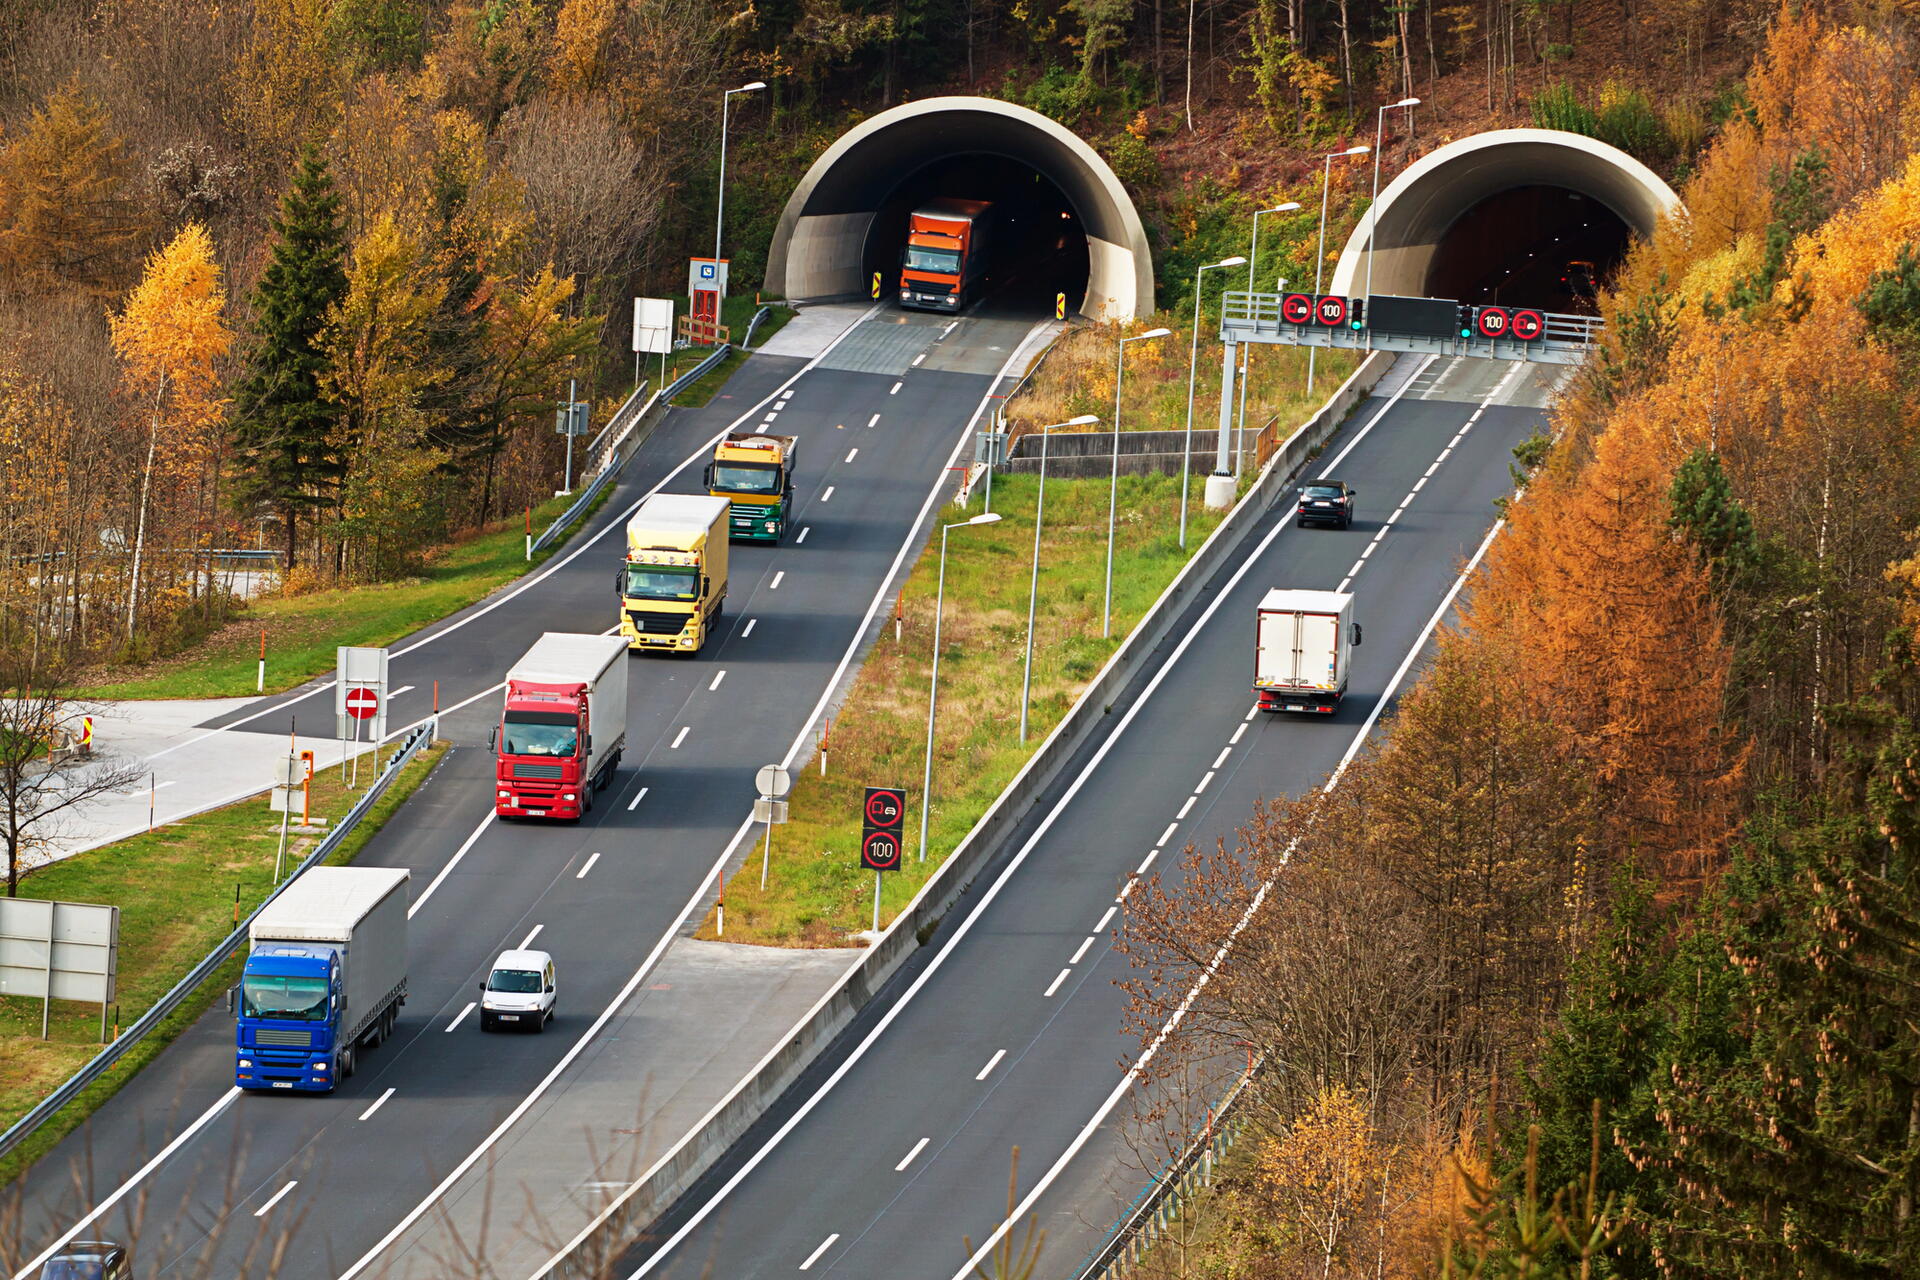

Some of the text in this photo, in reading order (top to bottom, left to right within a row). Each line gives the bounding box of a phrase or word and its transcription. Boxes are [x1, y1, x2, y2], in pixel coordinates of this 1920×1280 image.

[1322, 304, 1340, 317] 100
[1485, 315, 1503, 329] 100
[870, 842, 893, 858] 100
